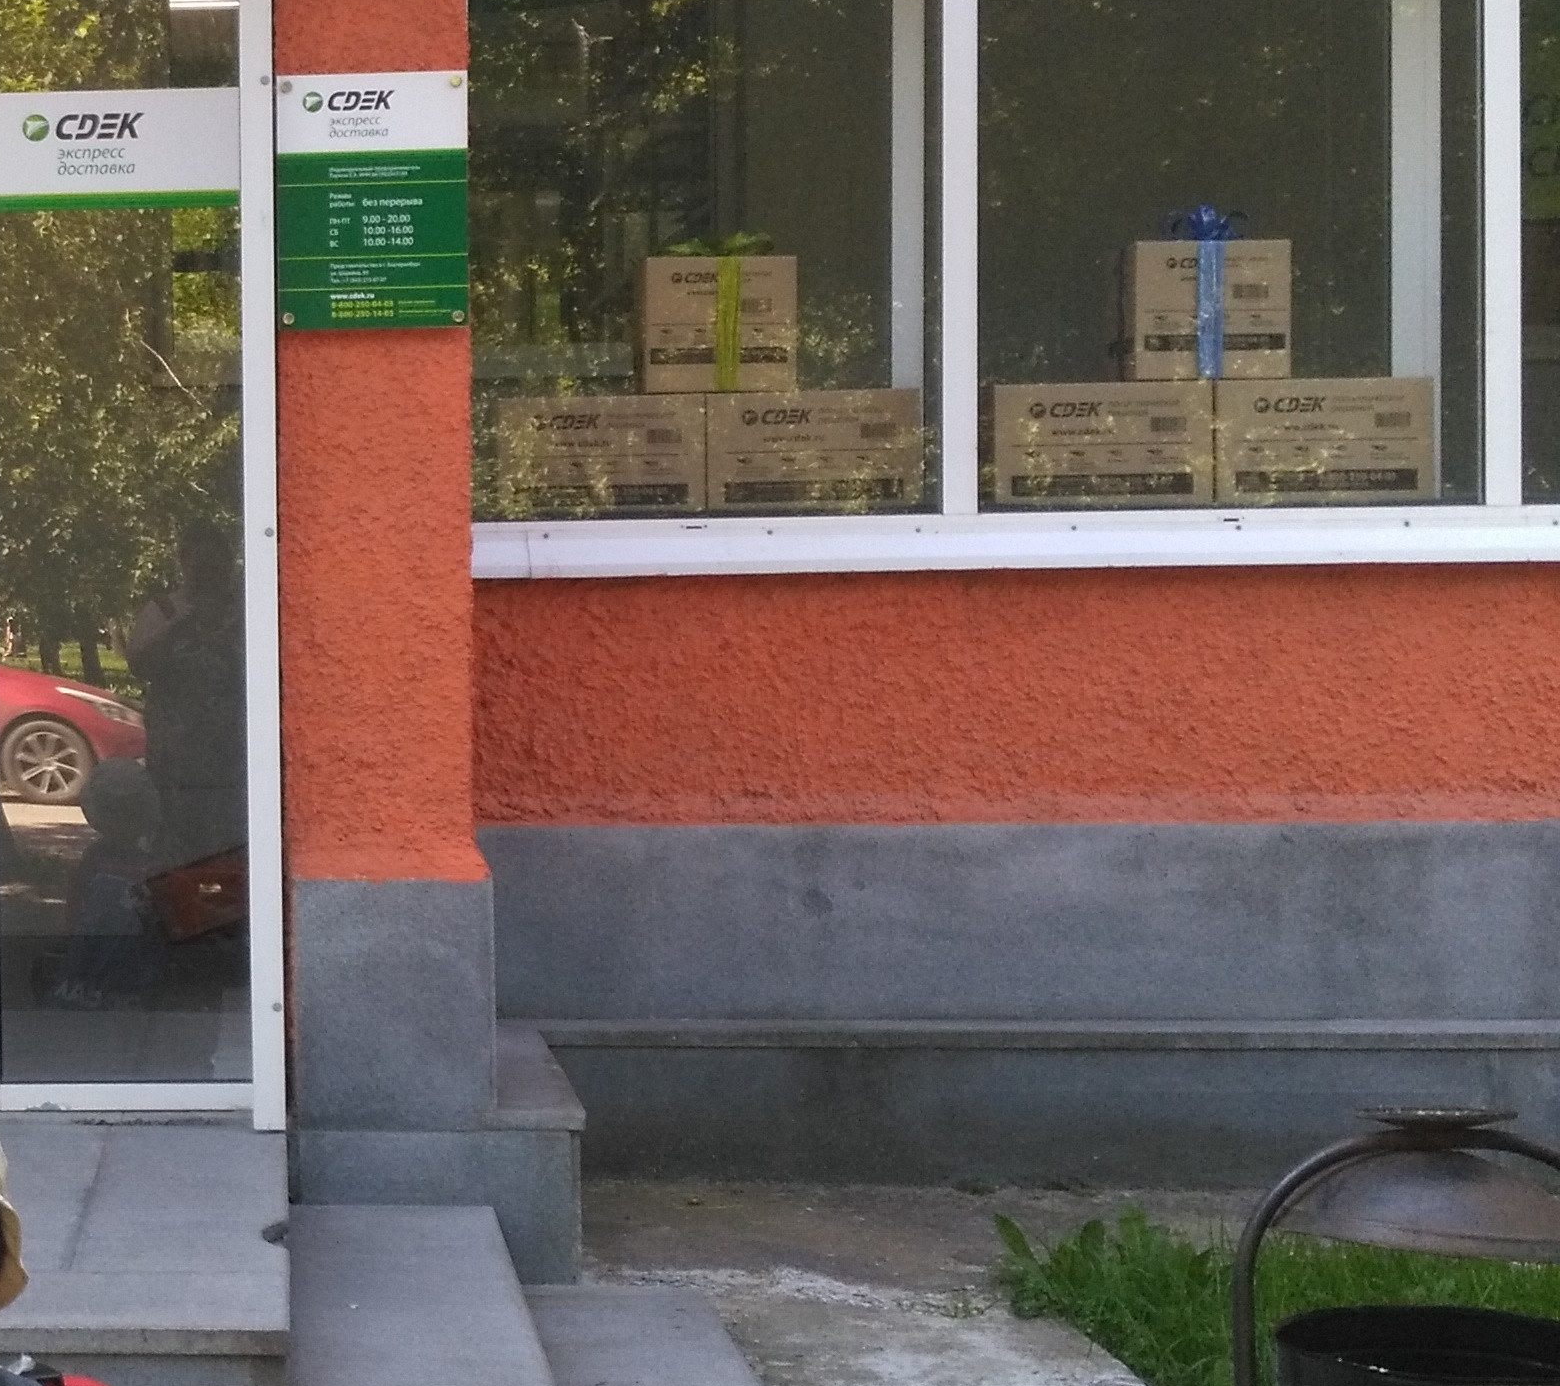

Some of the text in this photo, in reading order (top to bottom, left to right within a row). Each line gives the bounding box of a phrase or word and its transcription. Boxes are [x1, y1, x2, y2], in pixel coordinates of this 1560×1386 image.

[326, 89, 394, 111] CDEK
[55, 112, 144, 140] CDEK
[329, 116, 381, 127] экспресс
[329, 127, 389, 138] доставка
[57, 147, 126, 162] экспресс
[57, 160, 136, 176] доставка
[362, 198, 424, 208] без перерыва
[362, 214, 381, 224] 9.00
[387, 214, 411, 224] 20.00
[363, 226, 386, 235] 10.00
[363, 237, 386, 246] 10.00
[1049, 401, 1103, 418] CDEK
[1273, 396, 1327, 413] CDEK
[550, 414, 601, 430] CDEK
[761, 409, 813, 425] CDEK
